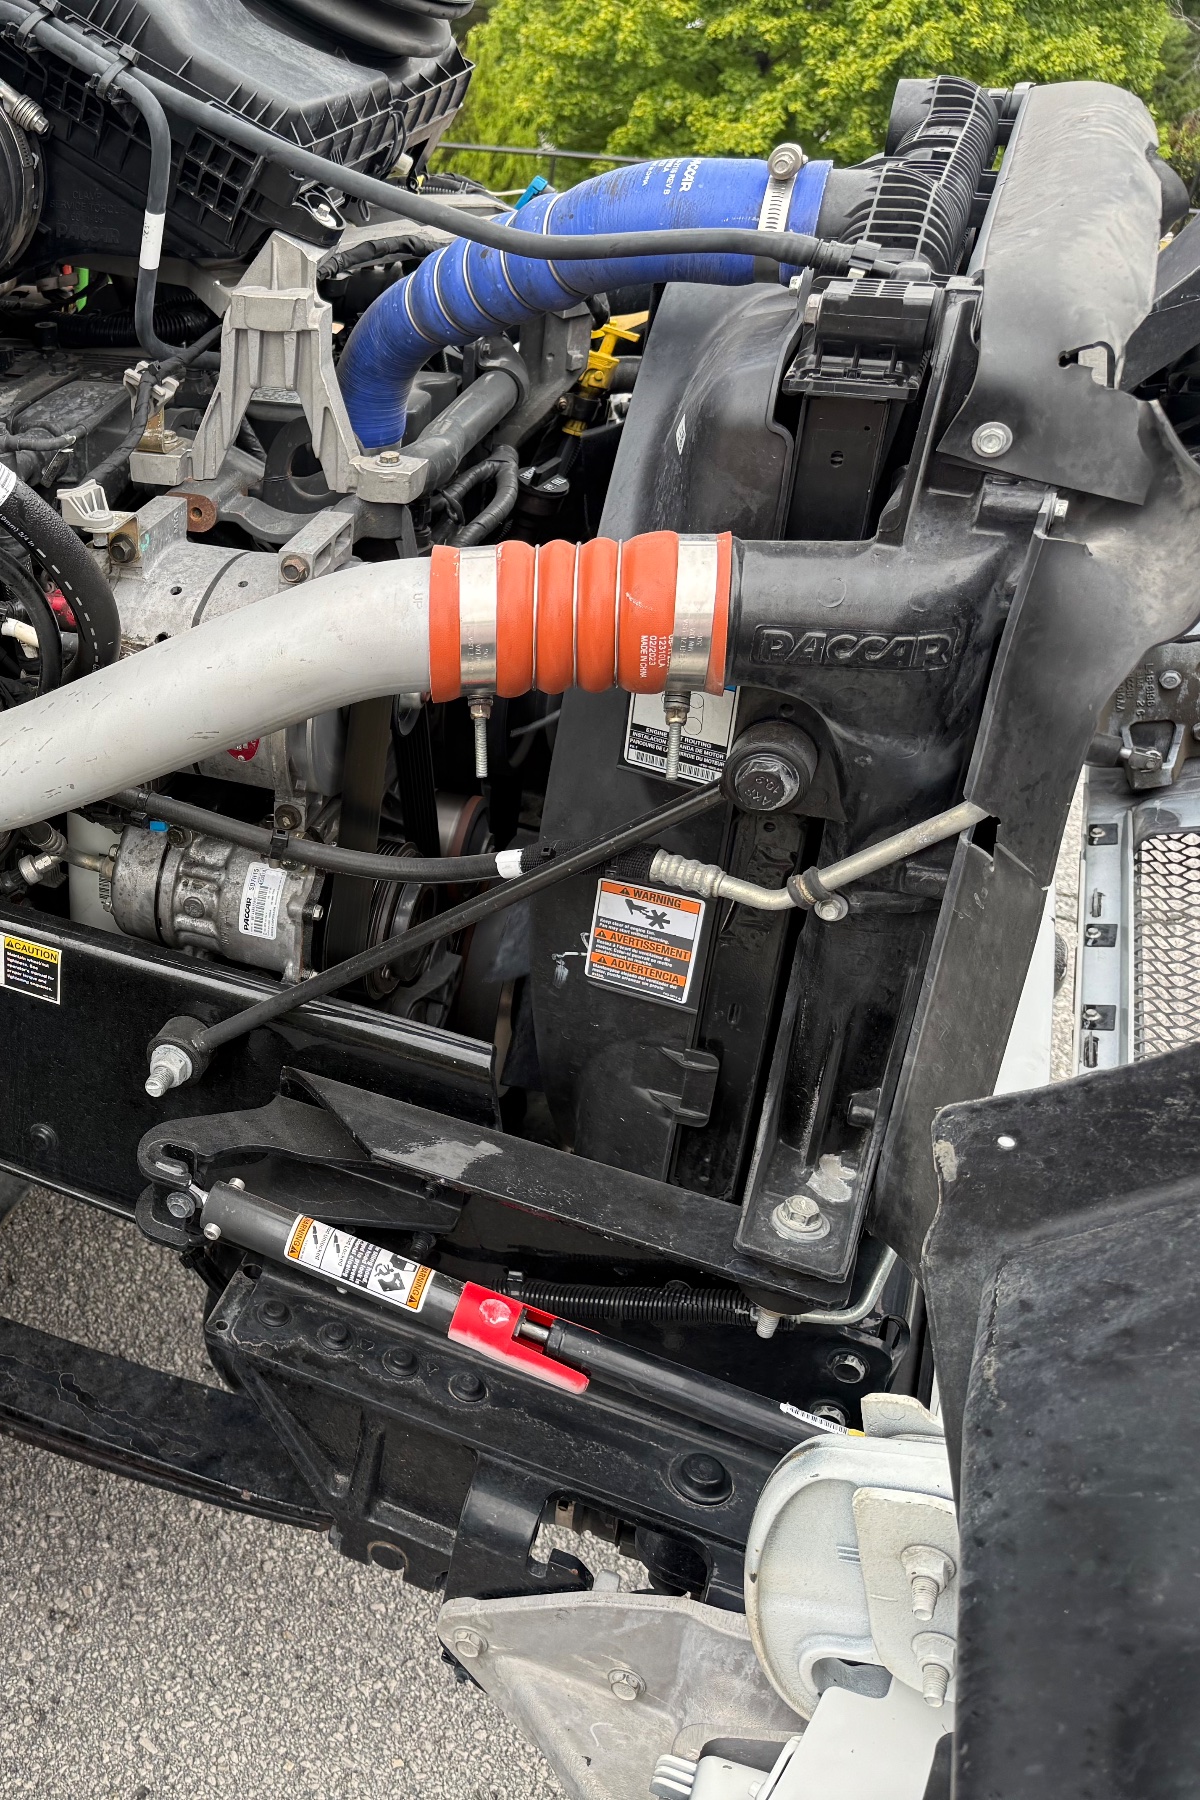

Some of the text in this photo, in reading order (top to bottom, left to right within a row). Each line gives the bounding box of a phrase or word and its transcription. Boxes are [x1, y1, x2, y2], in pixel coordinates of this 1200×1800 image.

[56, 222, 120, 243] PACCAR
[640, 635, 648, 655] MADE
[649, 635, 657, 666] 02/2023
[759, 629, 952, 667] PACCAR
[629, 737, 656, 749] PARCOURS
[632, 730, 666, 744] INSTALACION
[679, 743, 694, 751] ANDA
[703, 749, 724, 759] MOTOR
[645, 727, 667, 737] ENGINE
[684, 736, 712, 748] ROUTING
[634, 889, 681, 908] WARNING
[243, 897, 252, 931] PACCAR
[14, 941, 56, 961] CAUTION
[609, 930, 688, 961] AVERTISSEMENT
[610, 956, 679, 984] ADVERTENCIA
